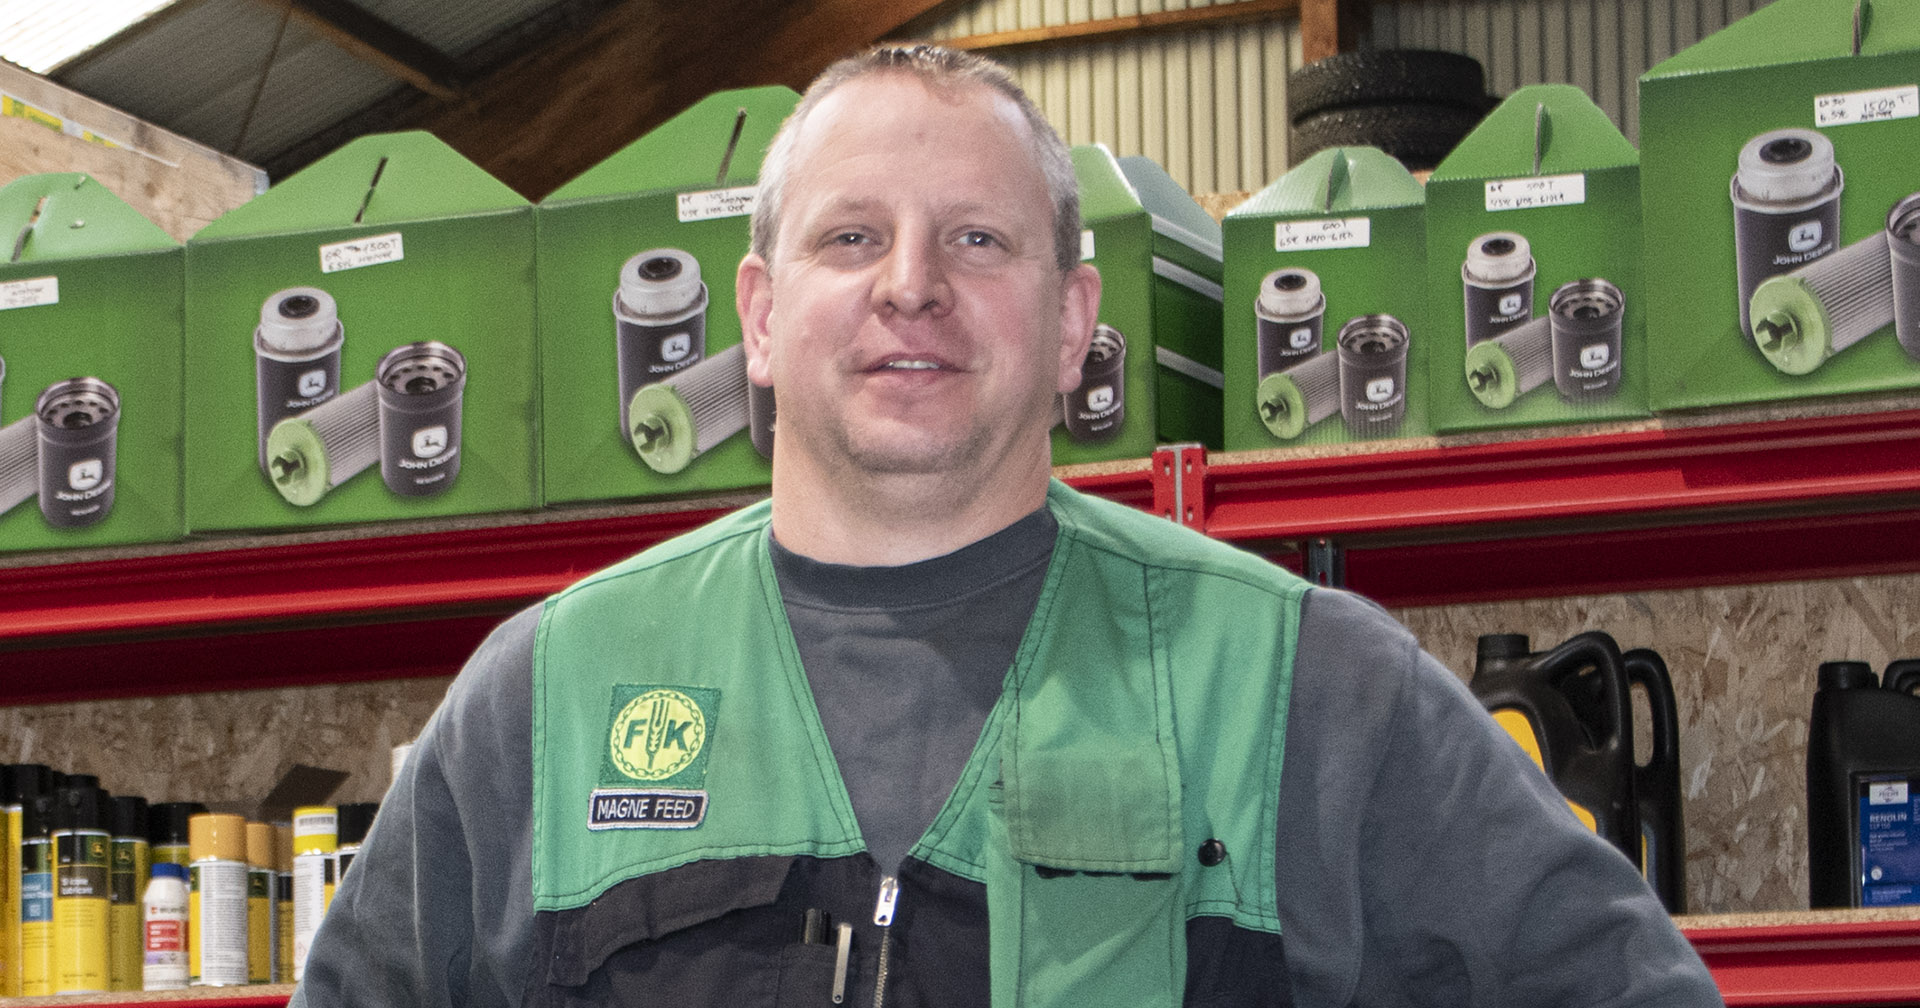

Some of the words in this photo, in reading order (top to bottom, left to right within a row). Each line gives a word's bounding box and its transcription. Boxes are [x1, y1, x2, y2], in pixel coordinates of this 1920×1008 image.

[1773, 254, 1802, 265] JOHN
[1804, 242, 1833, 261] DEERE
[649, 365, 674, 373] JOHN
[1569, 370, 1593, 378] JOHN
[286, 400, 311, 408] JOHN
[1355, 402, 1379, 410] JOHN
[1078, 412, 1100, 420] JOHN
[399, 459, 428, 469] JOHN
[55, 491, 84, 501] JOHN
[597, 799, 650, 820] MAGNE
[653, 799, 696, 819] FEED
[1869, 812, 1907, 823] RENOLIN
